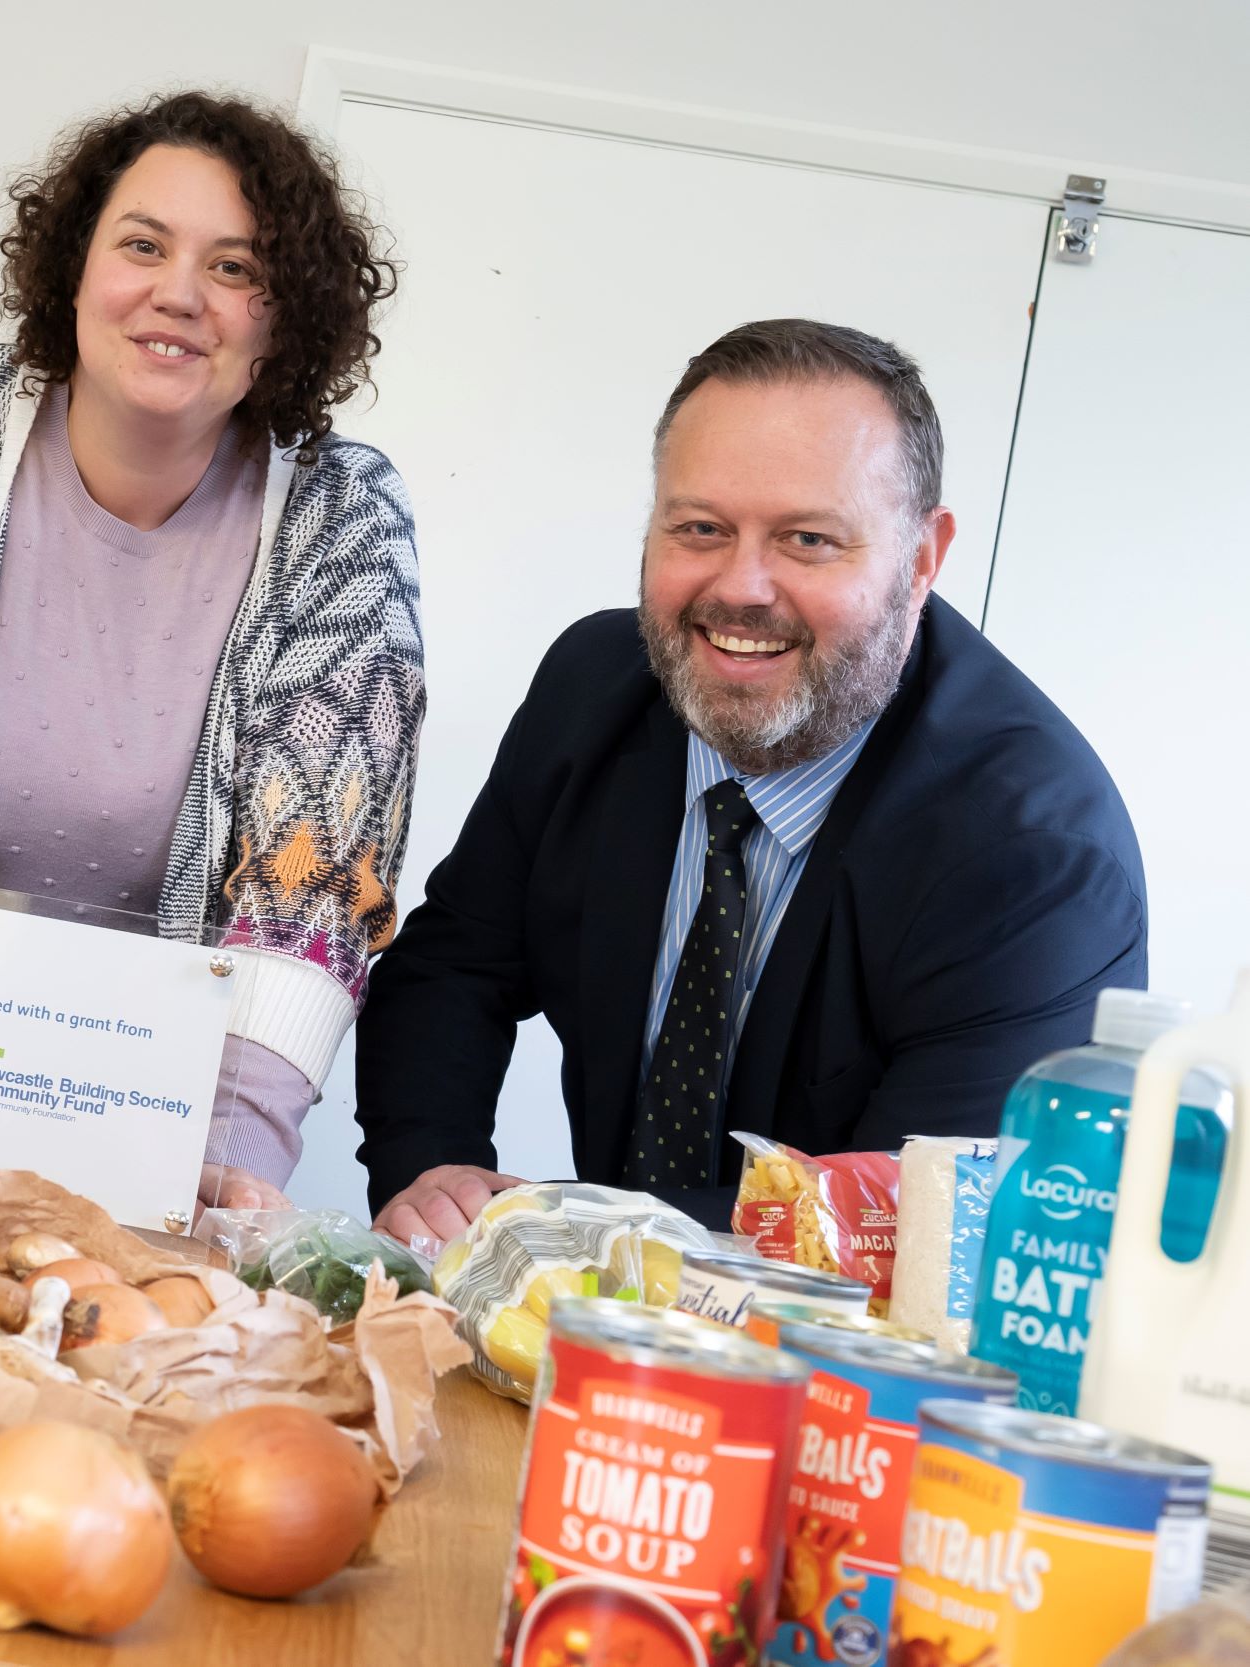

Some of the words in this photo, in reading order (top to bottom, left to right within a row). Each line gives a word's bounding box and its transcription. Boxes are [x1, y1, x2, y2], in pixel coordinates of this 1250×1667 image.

[17, 1004, 50, 1020] with
[55, 1012, 65, 1023] a
[69, 1015, 111, 1032] grant
[116, 1019, 153, 1039] from
[32, 1107, 76, 1122] Foundation
[59, 1077, 126, 1107] Building
[129, 1090, 192, 1119] Society
[63, 1094, 106, 1115] Fund
[1019, 1169, 1118, 1213] Lacura
[574, 1427, 665, 1469] CREAM
[670, 1450, 712, 1476] OF
[798, 1423, 892, 1499] BALLS
[561, 1449, 714, 1542] TOMATO
[558, 1513, 696, 1578] SOUP
[902, 1509, 1052, 1613] EATBALLS
